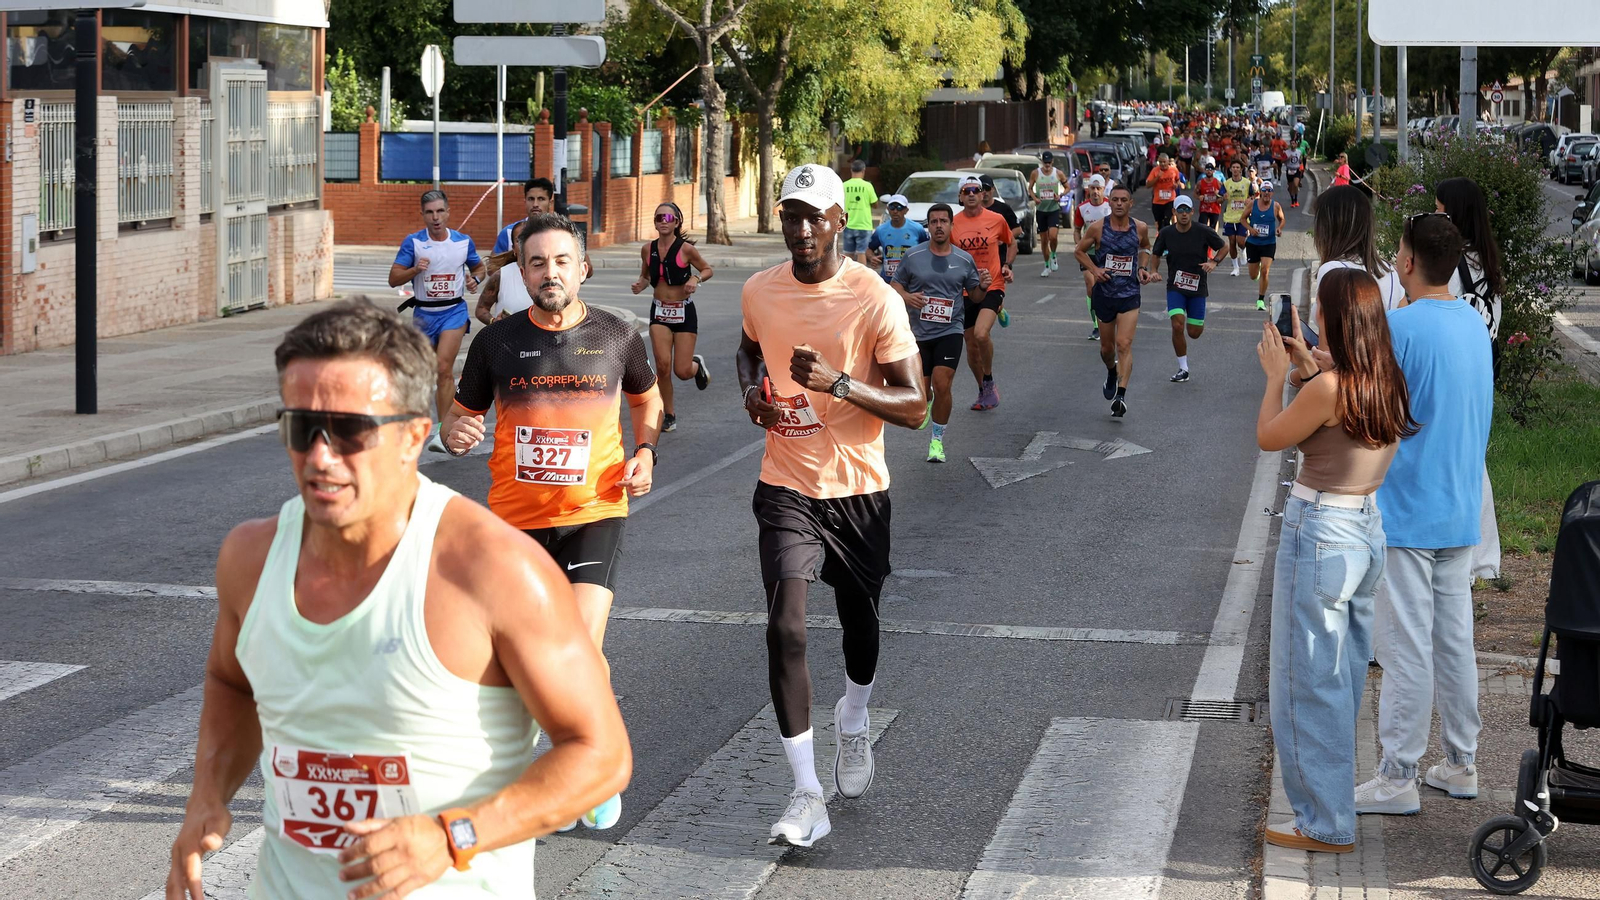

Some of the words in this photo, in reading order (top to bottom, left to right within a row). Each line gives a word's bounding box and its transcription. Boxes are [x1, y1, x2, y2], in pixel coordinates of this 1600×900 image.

[959, 236, 989, 248] XXIX
[432, 282, 449, 290] 458
[929, 305, 945, 315] 365
[510, 377, 529, 386] C.A.
[531, 375, 607, 385] CORREPLAYAS
[532, 446, 571, 466] 327
[308, 786, 378, 822] 367
